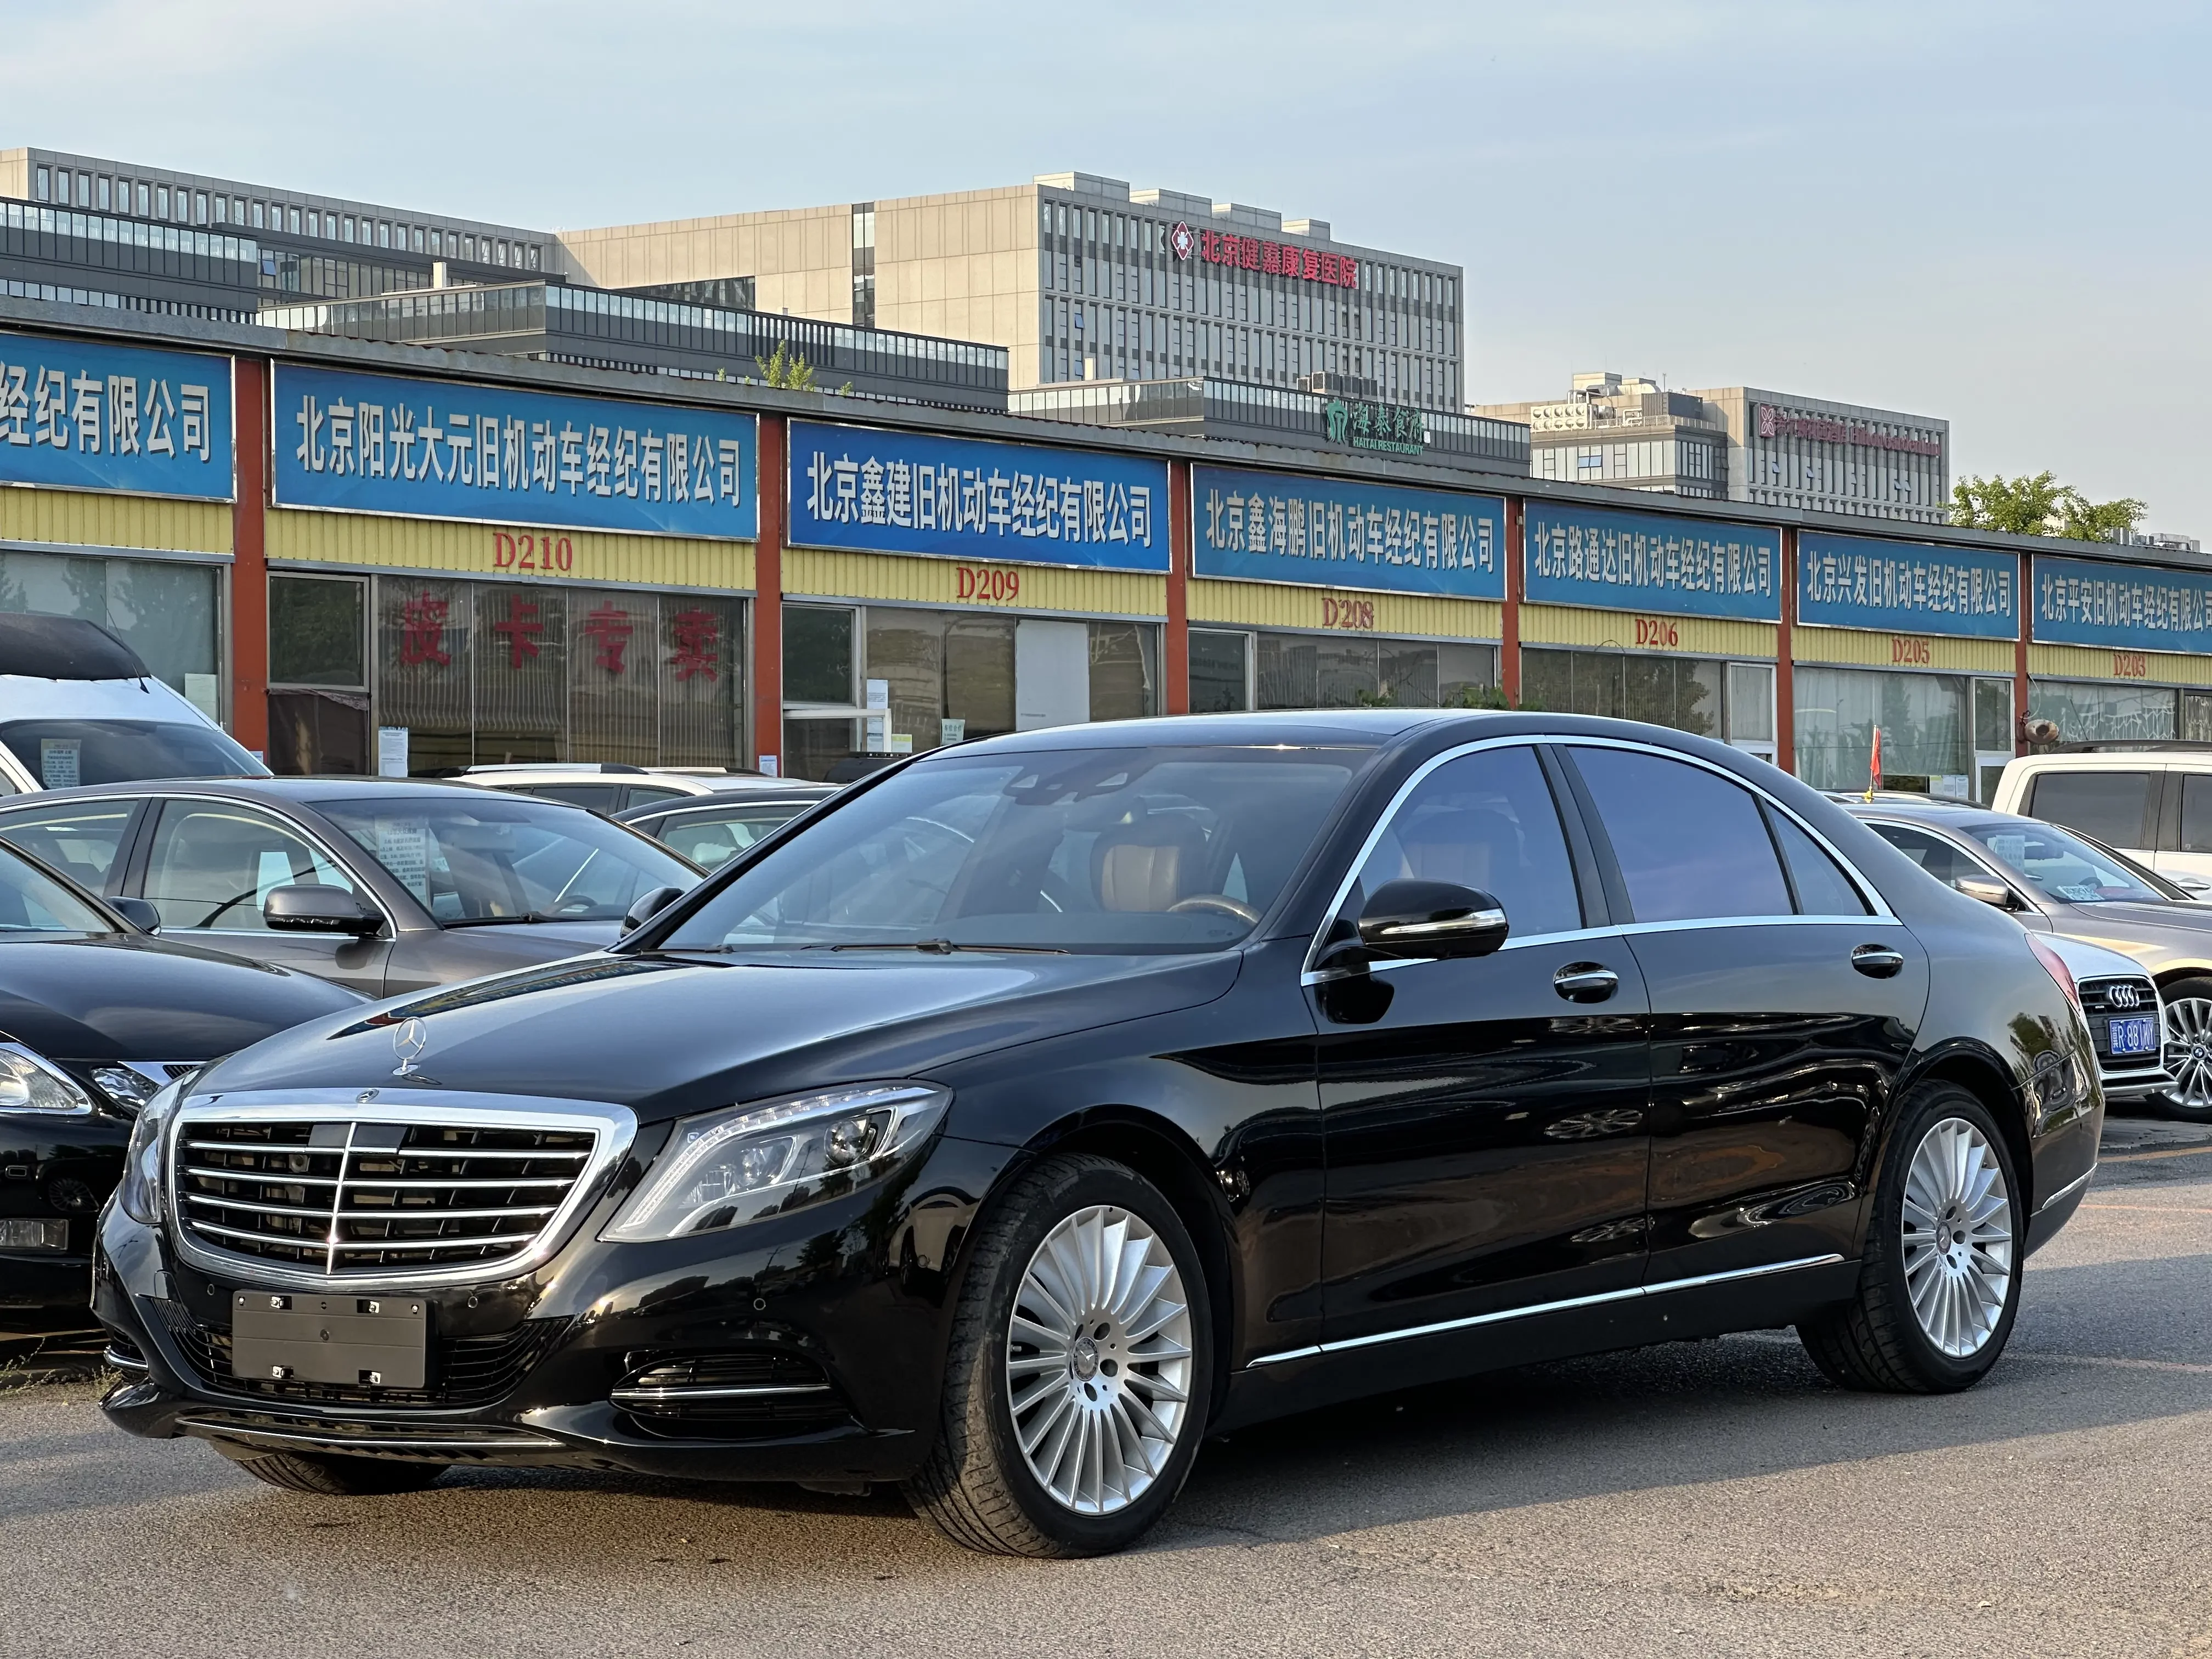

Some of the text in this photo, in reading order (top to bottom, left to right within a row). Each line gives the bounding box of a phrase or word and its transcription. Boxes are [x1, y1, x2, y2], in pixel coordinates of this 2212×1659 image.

[1201, 230, 1357, 288] 北京健嘉康复医院
[0, 361, 210, 461] 经纪有限公司
[296, 394, 740, 506] 北京阳光大元旧机动车经纪有限公司
[807, 451, 1150, 548] 北京鑫建旧机动车经纪有限公司
[493, 532, 572, 572] D210
[1206, 488, 1494, 573] 北京鑫海鹏旧机动车经纪有限公司
[1534, 522, 1771, 597] 北京路通达旧机动车经纪有限公司
[957, 567, 1019, 601] D209
[1322, 597, 1374, 629] D208
[1807, 550, 2011, 617] 北京兴发旧机动车经纪有限公司
[2041, 573, 2212, 633] 北京平安旧机动车经纪有限公司
[401, 589, 719, 682] 皮卡专卖
[1635, 619, 1679, 646] D206
[1892, 639, 1930, 663] D205
[2113, 654, 2146, 677] D203
